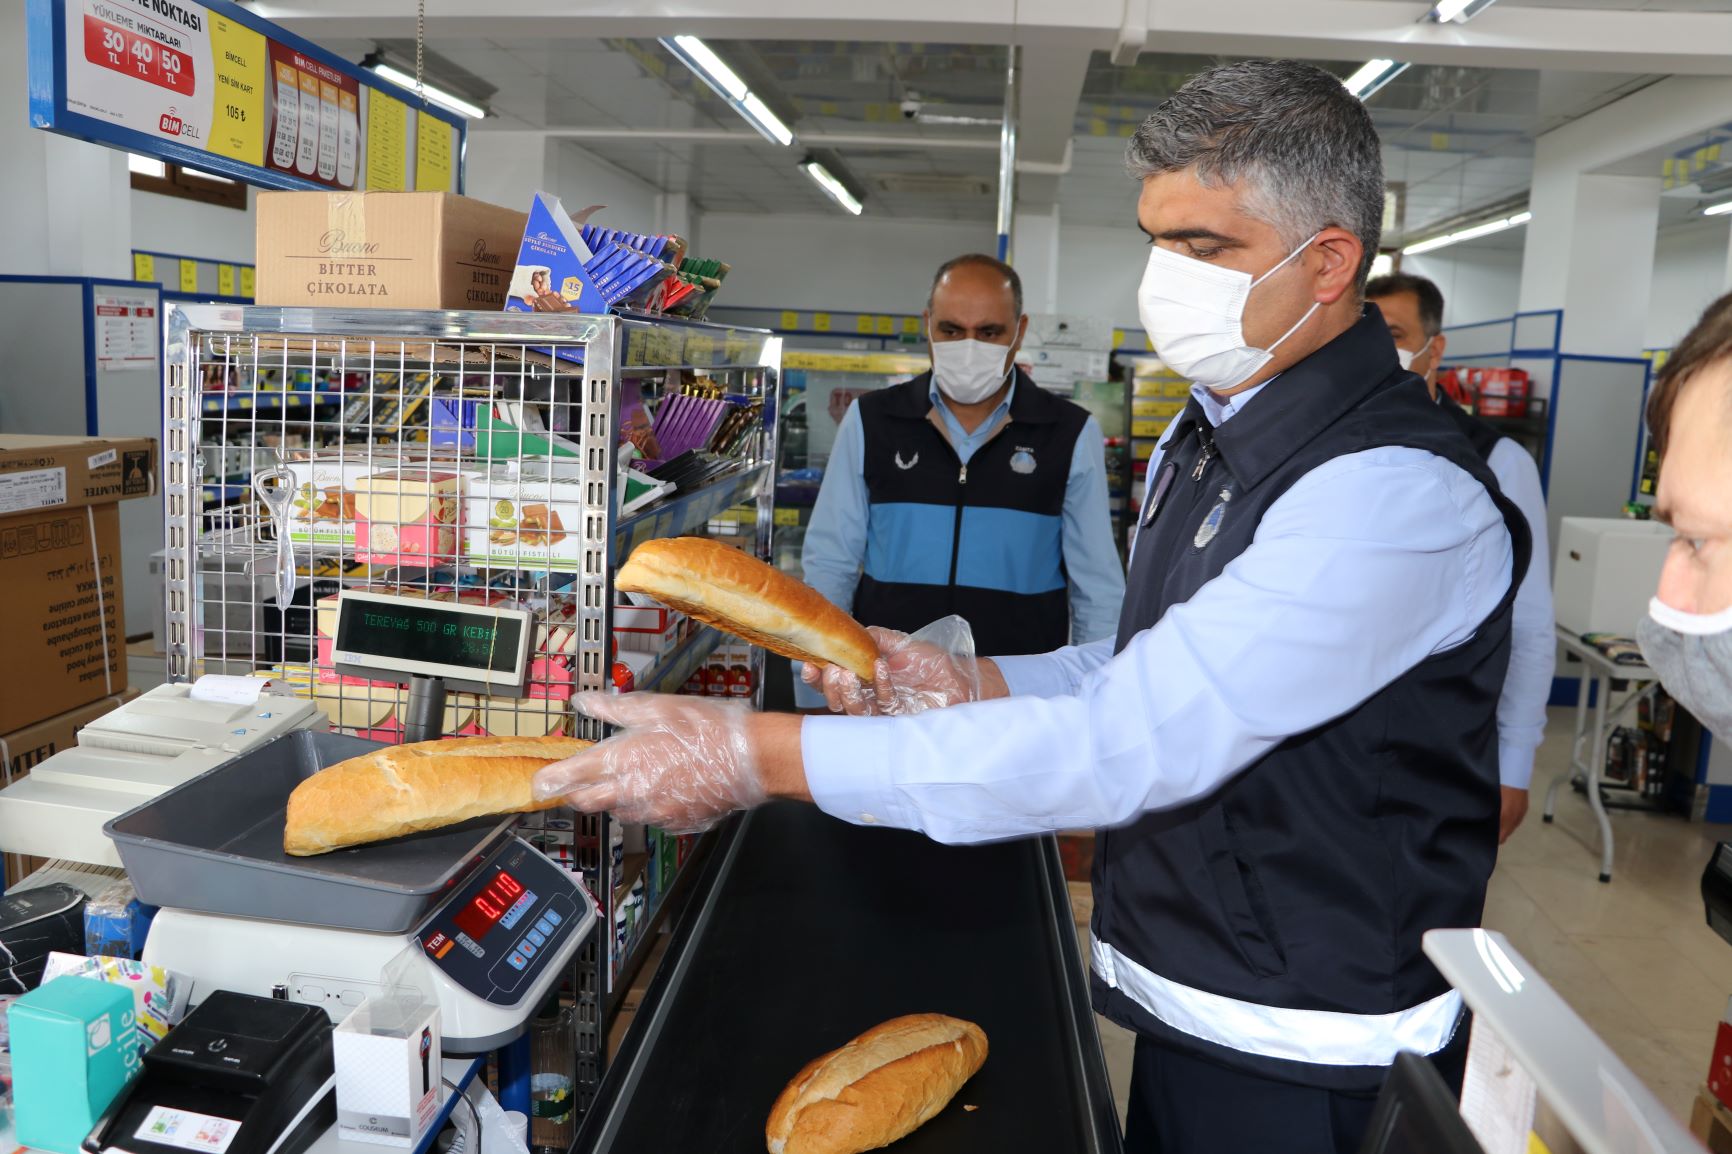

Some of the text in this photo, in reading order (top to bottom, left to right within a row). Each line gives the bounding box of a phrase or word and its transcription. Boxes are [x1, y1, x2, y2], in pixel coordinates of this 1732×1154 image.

[152, 0, 201, 32] NOKTASI
[93, 3, 181, 49] YÜKLEME MİKTARLARI
[103, 27, 181, 74] 30 40 50
[108, 52, 177, 85] TL TL TL
[240, 83, 254, 95] KART
[226, 104, 239, 119] 105
[319, 260, 377, 276] BİTTER
[472, 270, 499, 286] BİTTER
[307, 280, 388, 297] ÇİKOLATA
[84, 484, 122, 497] KUMTEL
[416, 620, 437, 633] 500
[443, 624, 457, 635] GR
[66, 658, 87, 674] hood
[344, 654, 363, 664] IBM
[427, 932, 446, 951] TEM
